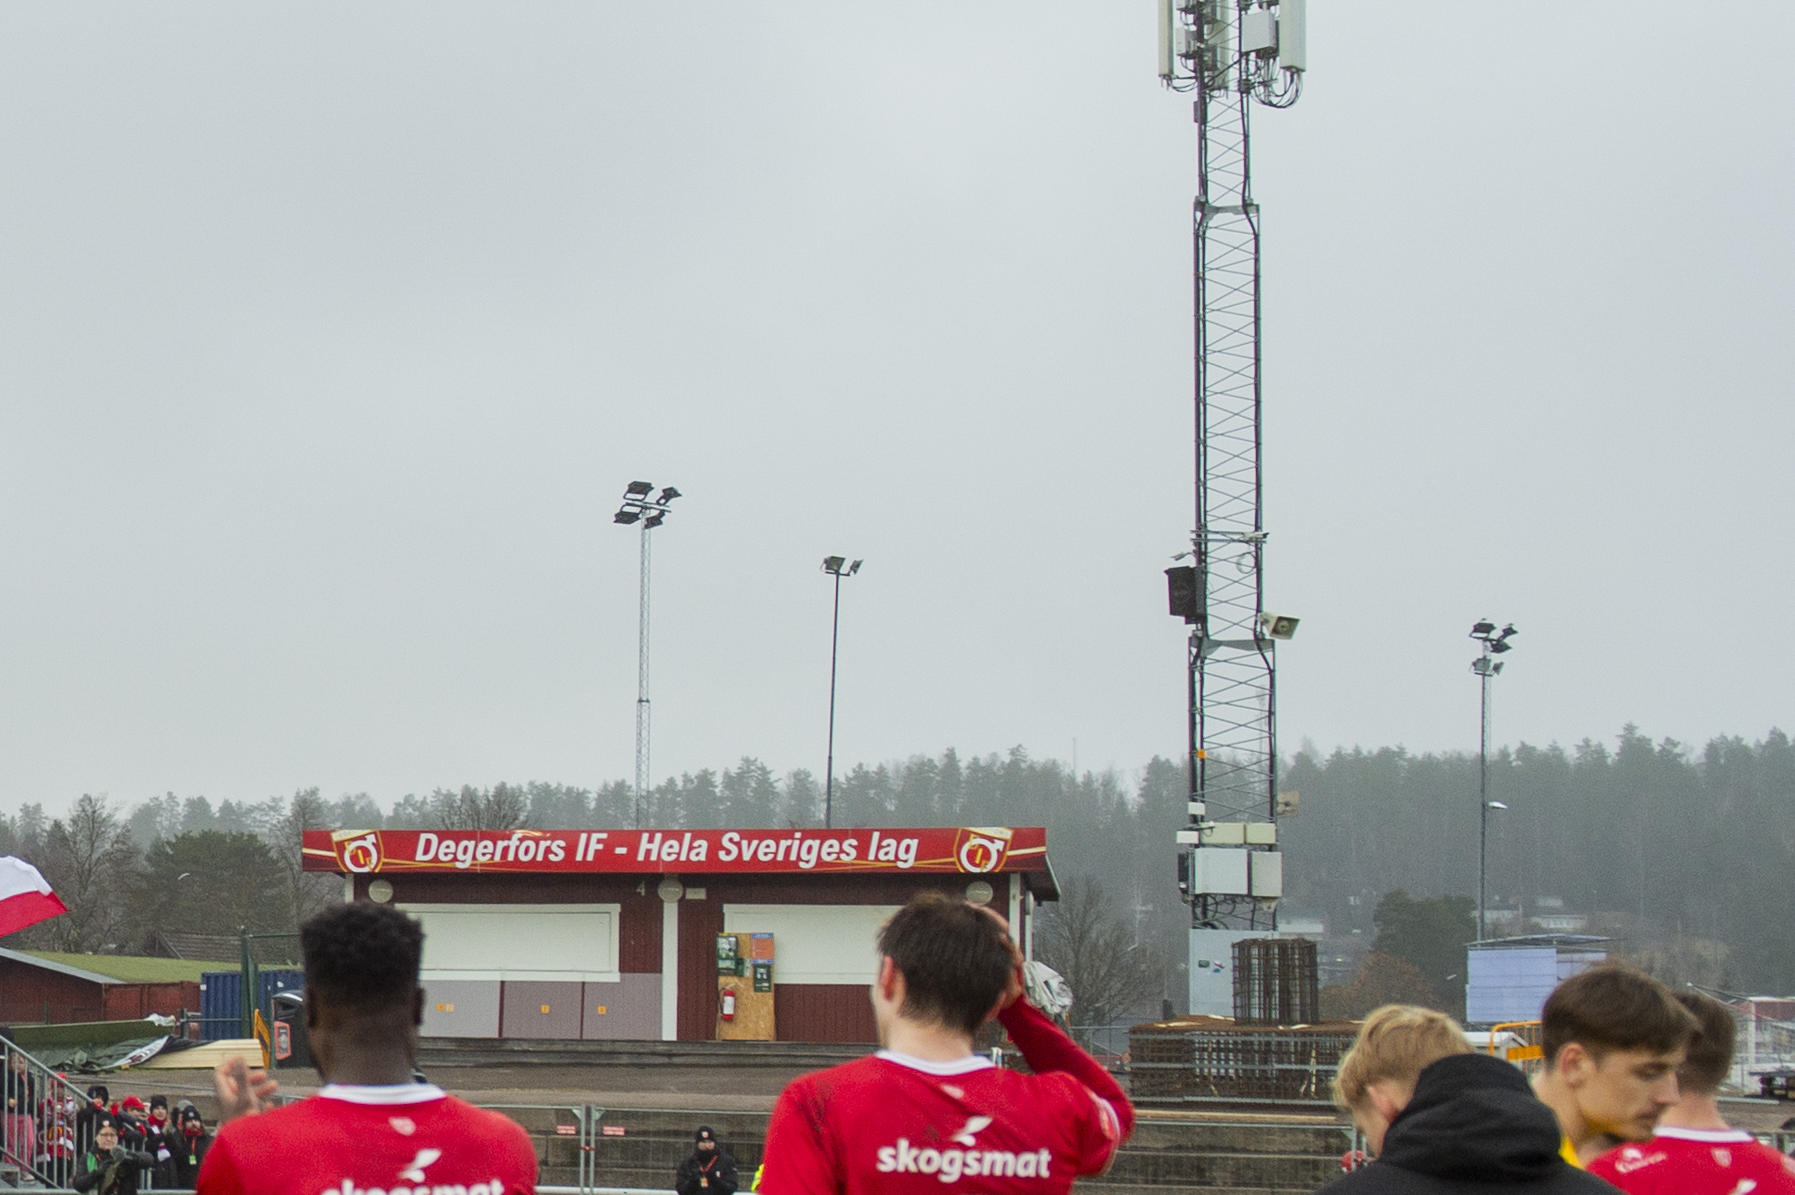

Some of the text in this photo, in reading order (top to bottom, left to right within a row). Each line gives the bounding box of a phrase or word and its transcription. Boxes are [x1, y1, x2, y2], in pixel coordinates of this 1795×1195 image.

[415, 832, 566, 869] Degerfors
[575, 832, 608, 862] IF
[637, 832, 708, 862] Hela
[717, 831, 858, 869] Sveriges
[868, 831, 919, 869] lag
[877, 1138, 1052, 1183] skogsmat
